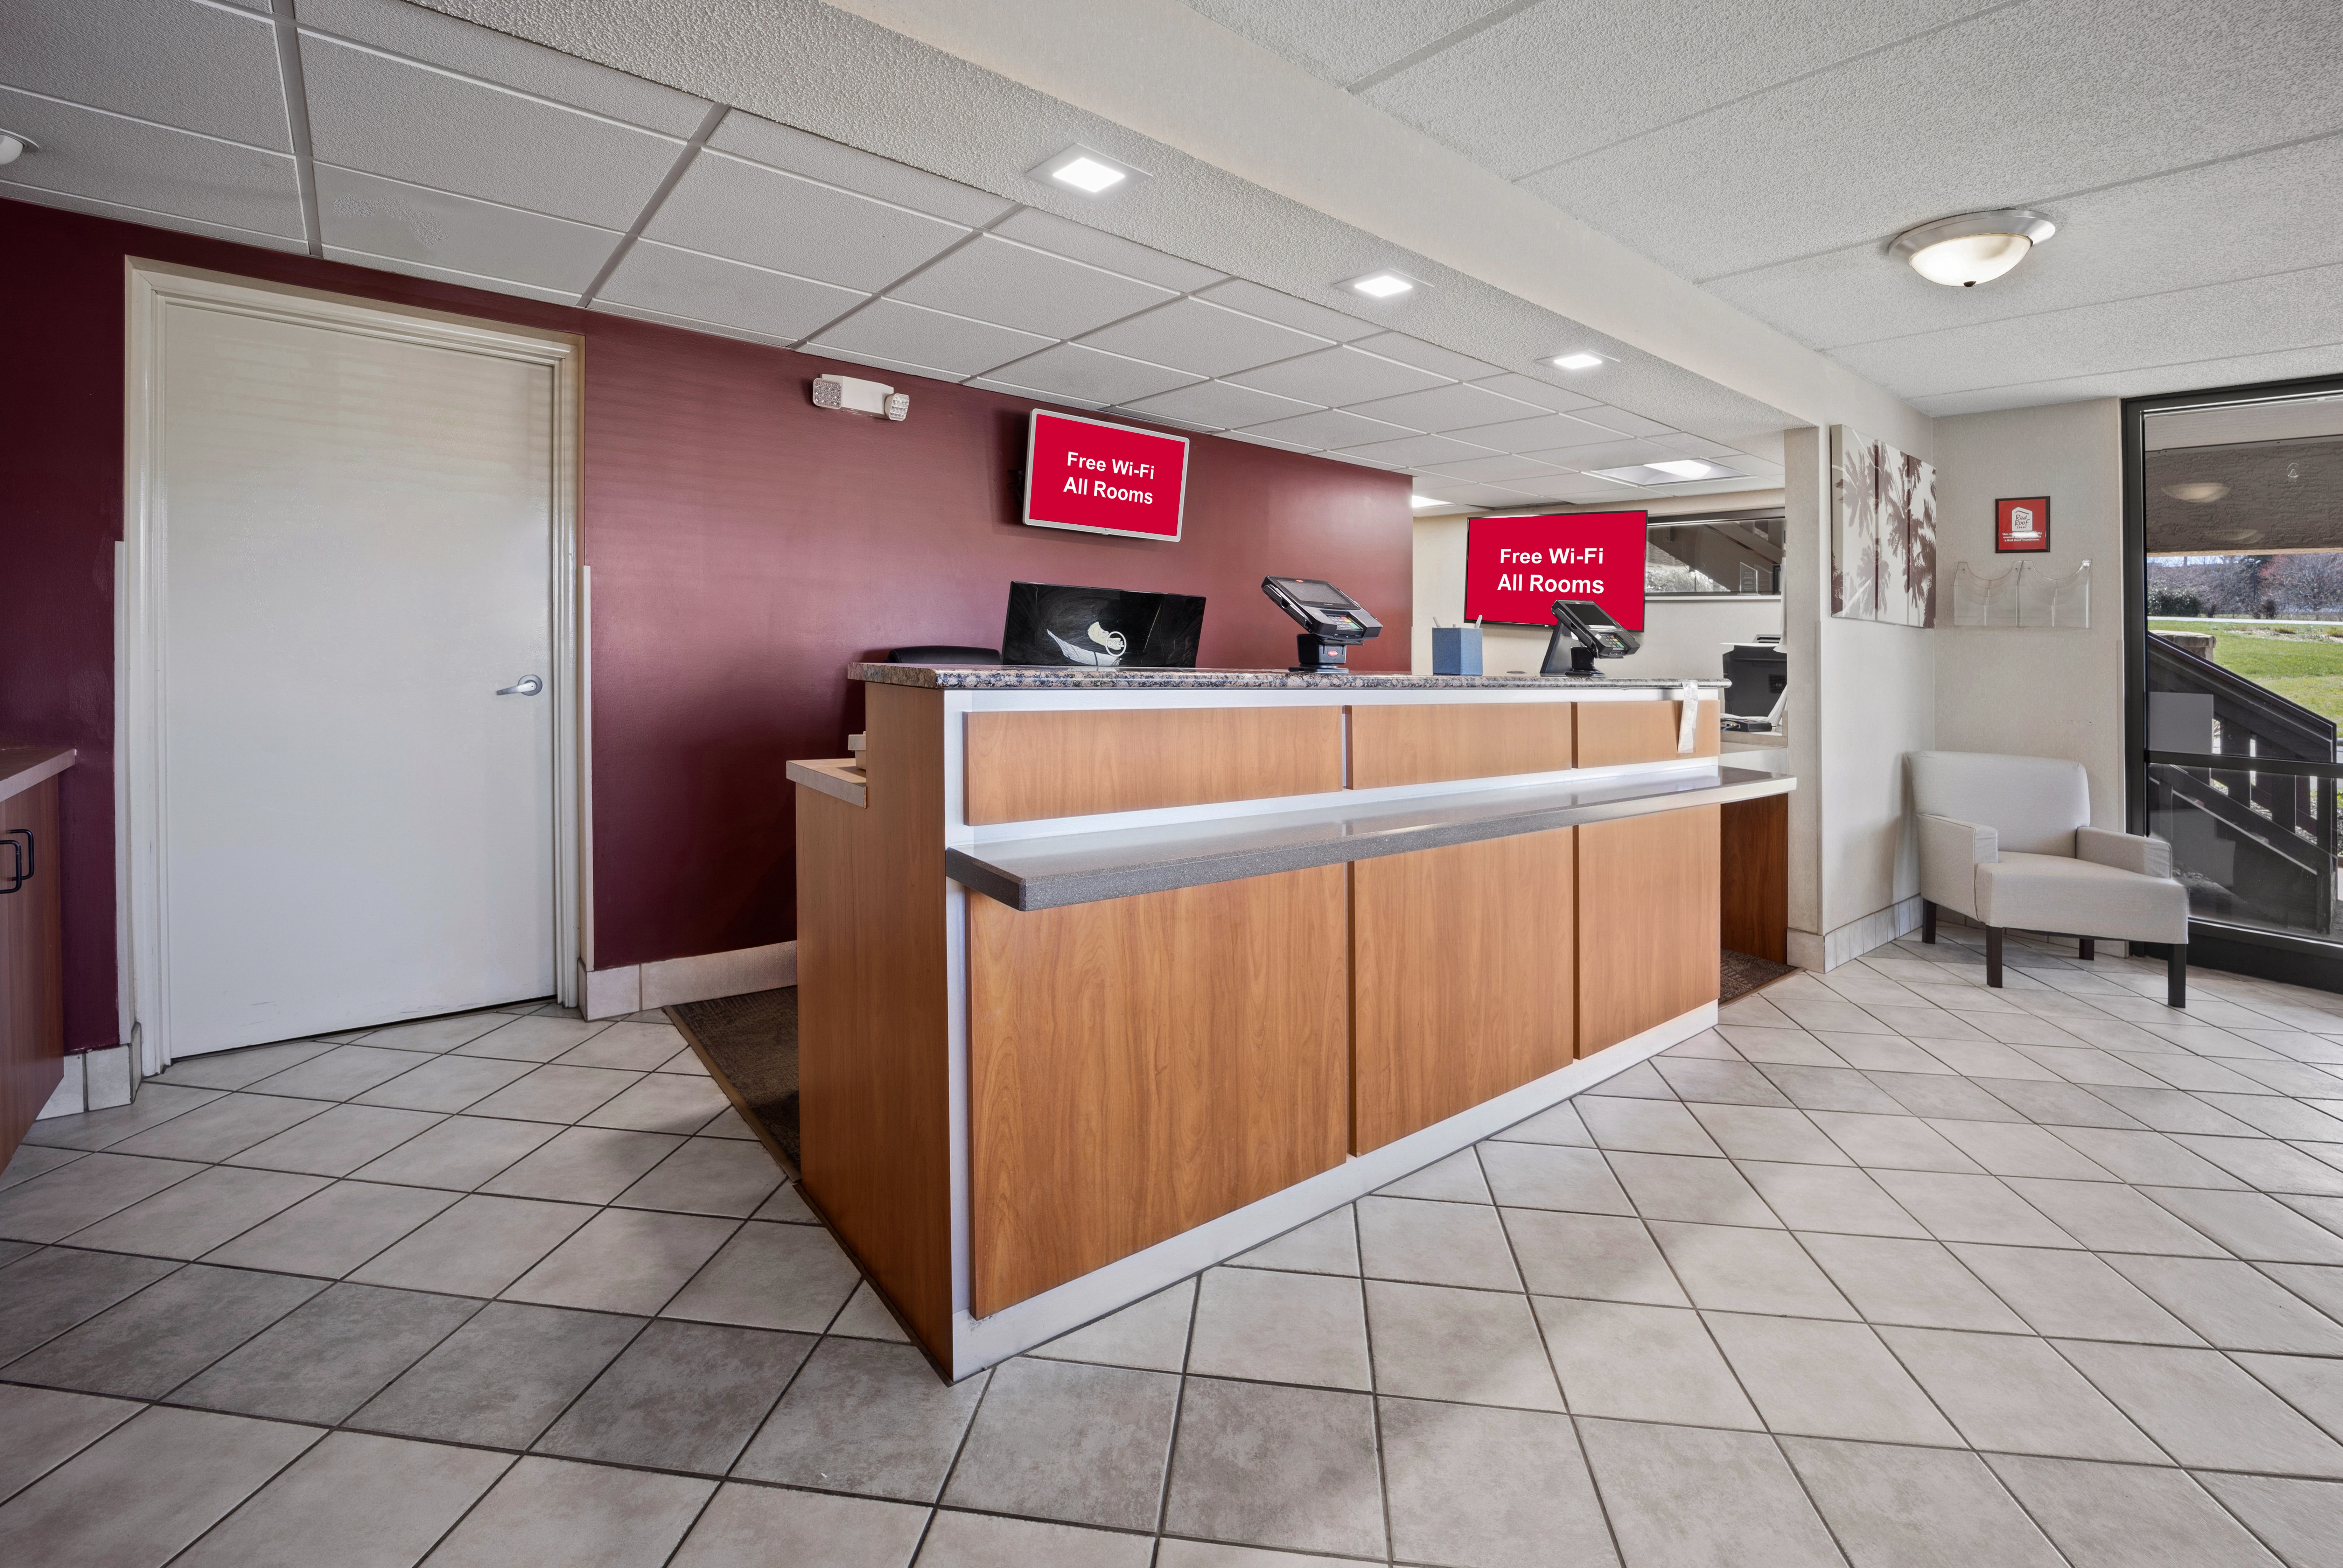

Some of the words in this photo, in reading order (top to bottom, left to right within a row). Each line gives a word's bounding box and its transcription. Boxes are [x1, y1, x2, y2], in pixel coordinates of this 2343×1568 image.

[1067, 451, 1106, 471] Free
[1112, 458, 1154, 479] Wi-Fi
[1063, 476, 1088, 495] All
[1093, 480, 1153, 504] Rooms
[1500, 548, 1542, 564] Free
[1549, 548, 1603, 564] Wi-Fi
[1497, 574, 1523, 591] All
[1530, 574, 1604, 594] Rooms
